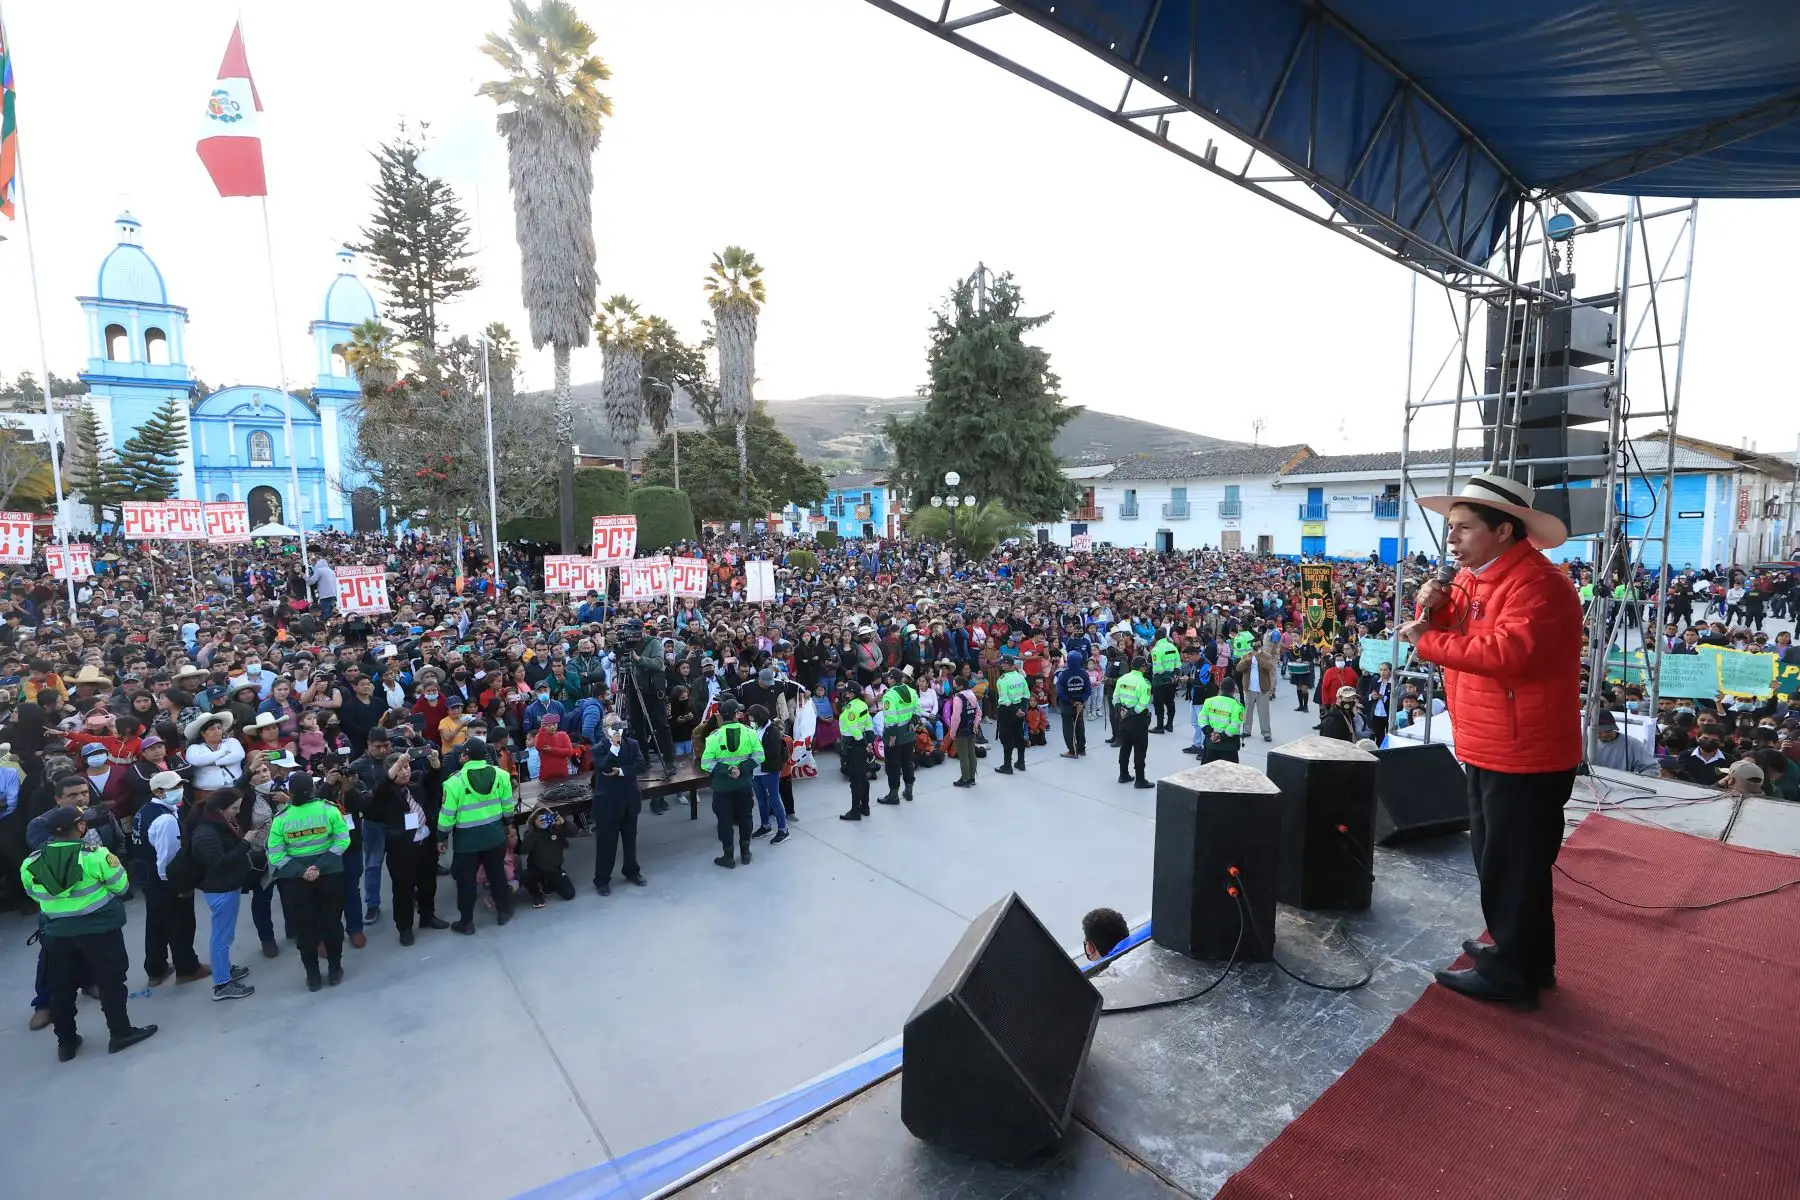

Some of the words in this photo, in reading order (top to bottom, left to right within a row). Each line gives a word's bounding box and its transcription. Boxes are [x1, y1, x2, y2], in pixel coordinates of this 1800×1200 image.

[3, 513, 22, 521] COMO
[23, 512, 32, 521] TU
[167, 507, 201, 532] PCT
[207, 510, 247, 535] PCT
[593, 528, 636, 560] PCT
[545, 562, 570, 588] PC
[673, 565, 707, 592] PCT
[339, 576, 384, 609] PCT
